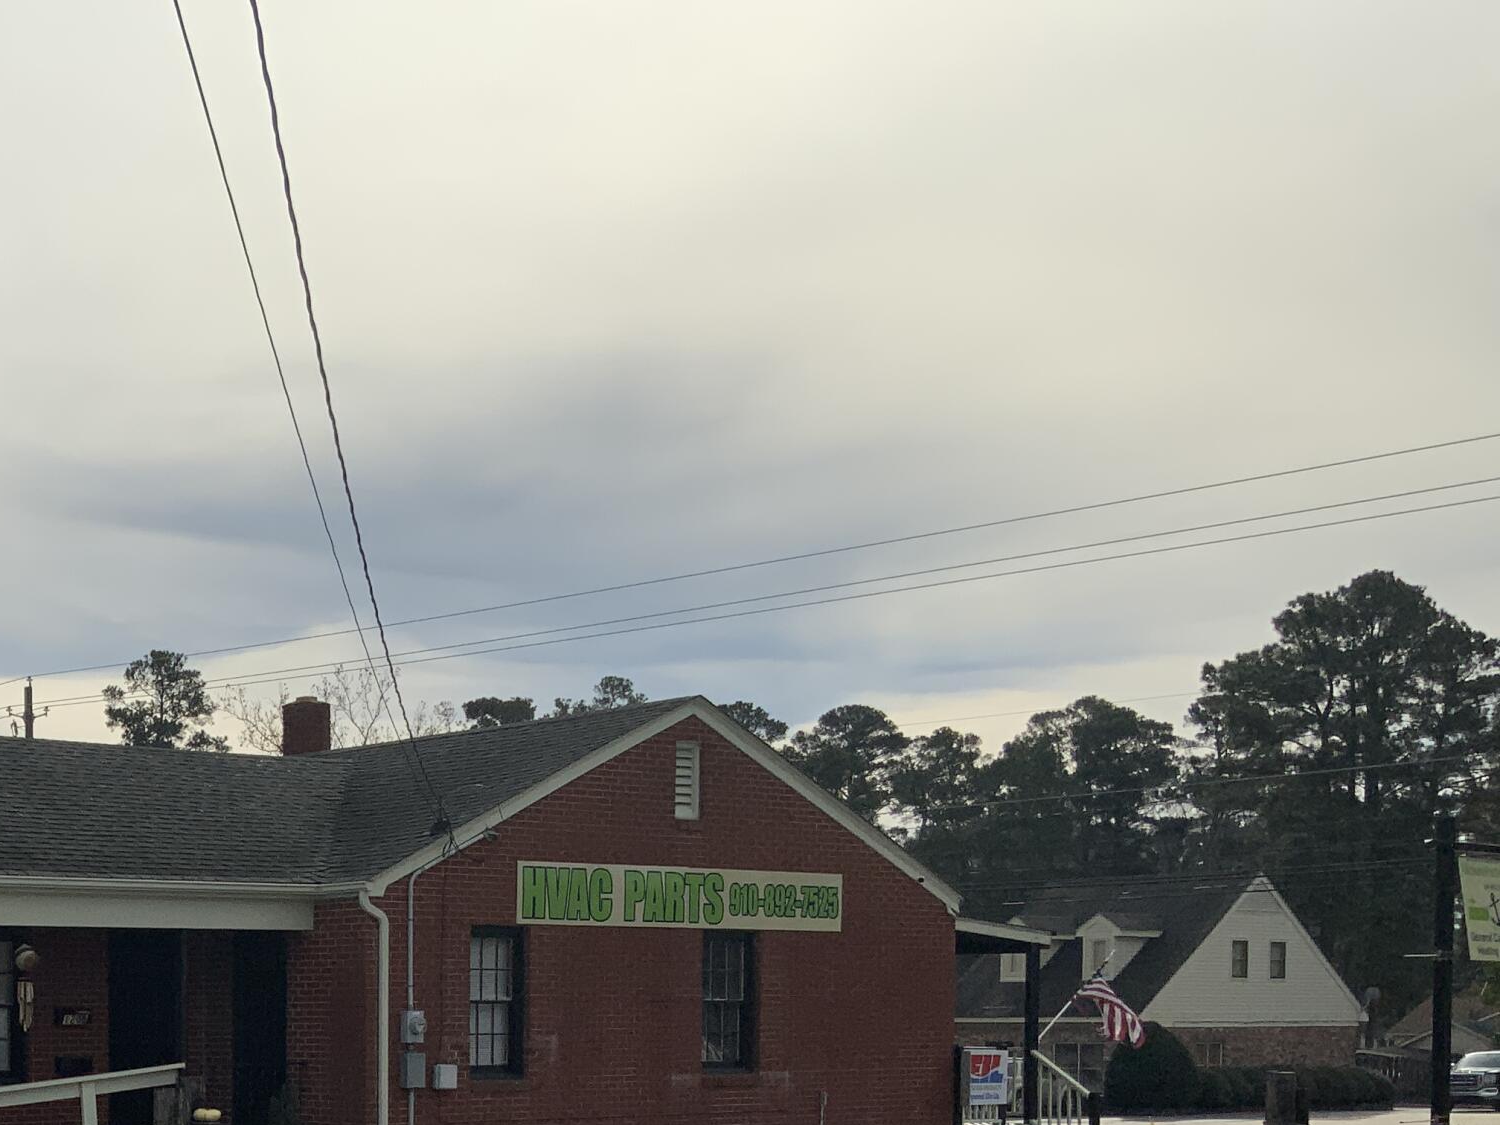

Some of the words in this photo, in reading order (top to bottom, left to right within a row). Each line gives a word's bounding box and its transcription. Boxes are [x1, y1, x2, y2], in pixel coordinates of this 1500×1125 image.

[522, 866, 613, 922] HVAC
[624, 869, 725, 925] PARTS
[729, 882, 839, 919] 910-892-7525
